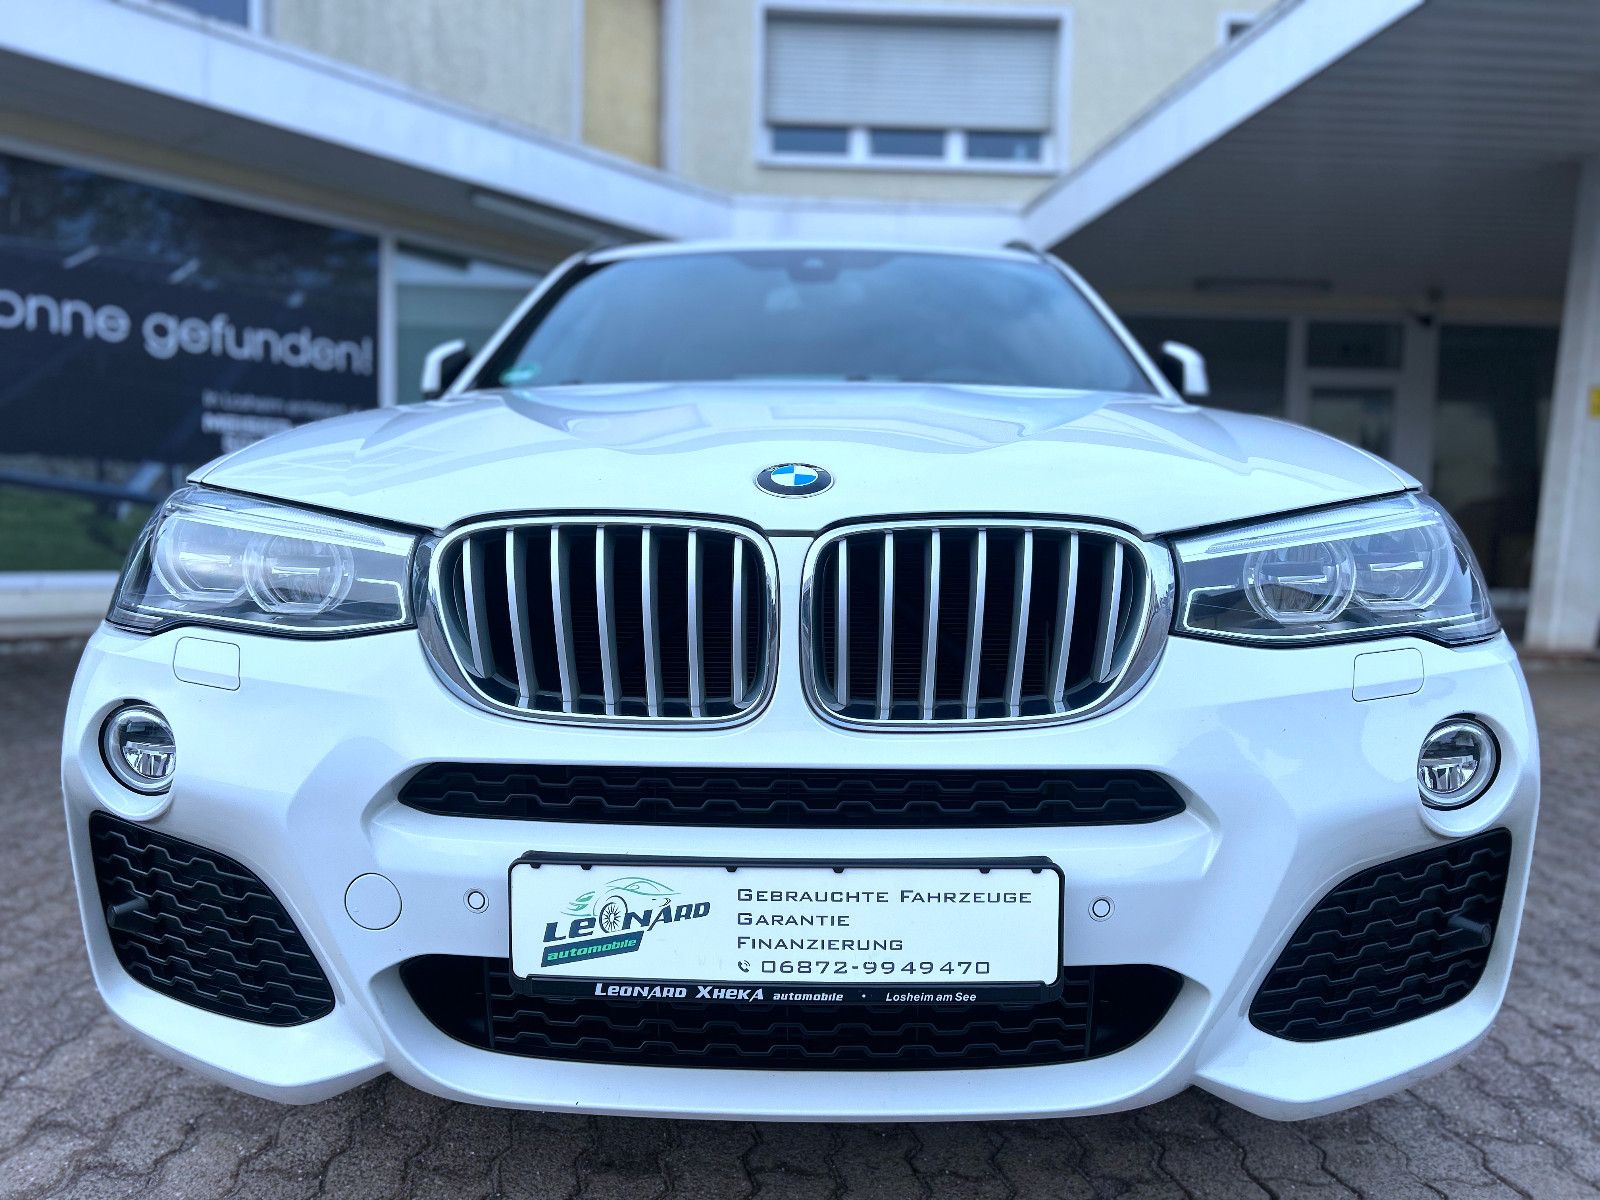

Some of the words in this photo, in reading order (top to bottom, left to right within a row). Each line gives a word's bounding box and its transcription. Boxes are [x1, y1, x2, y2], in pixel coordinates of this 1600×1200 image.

[142, 312, 373, 376] gefunden!
[737, 888, 889, 903] GEBRAUCHTE
[900, 889, 1032, 903] FAHRZEUGE
[737, 912, 850, 927] GARANTIE
[547, 938, 637, 961] automobile
[737, 936, 904, 951] FINANZIERUNG
[761, 960, 990, 975] 06872-9949470
[772, 991, 844, 1002] automobile
[885, 992, 934, 1002] Losheim
[936, 993, 953, 1002] am
[954, 992, 977, 1002] See
